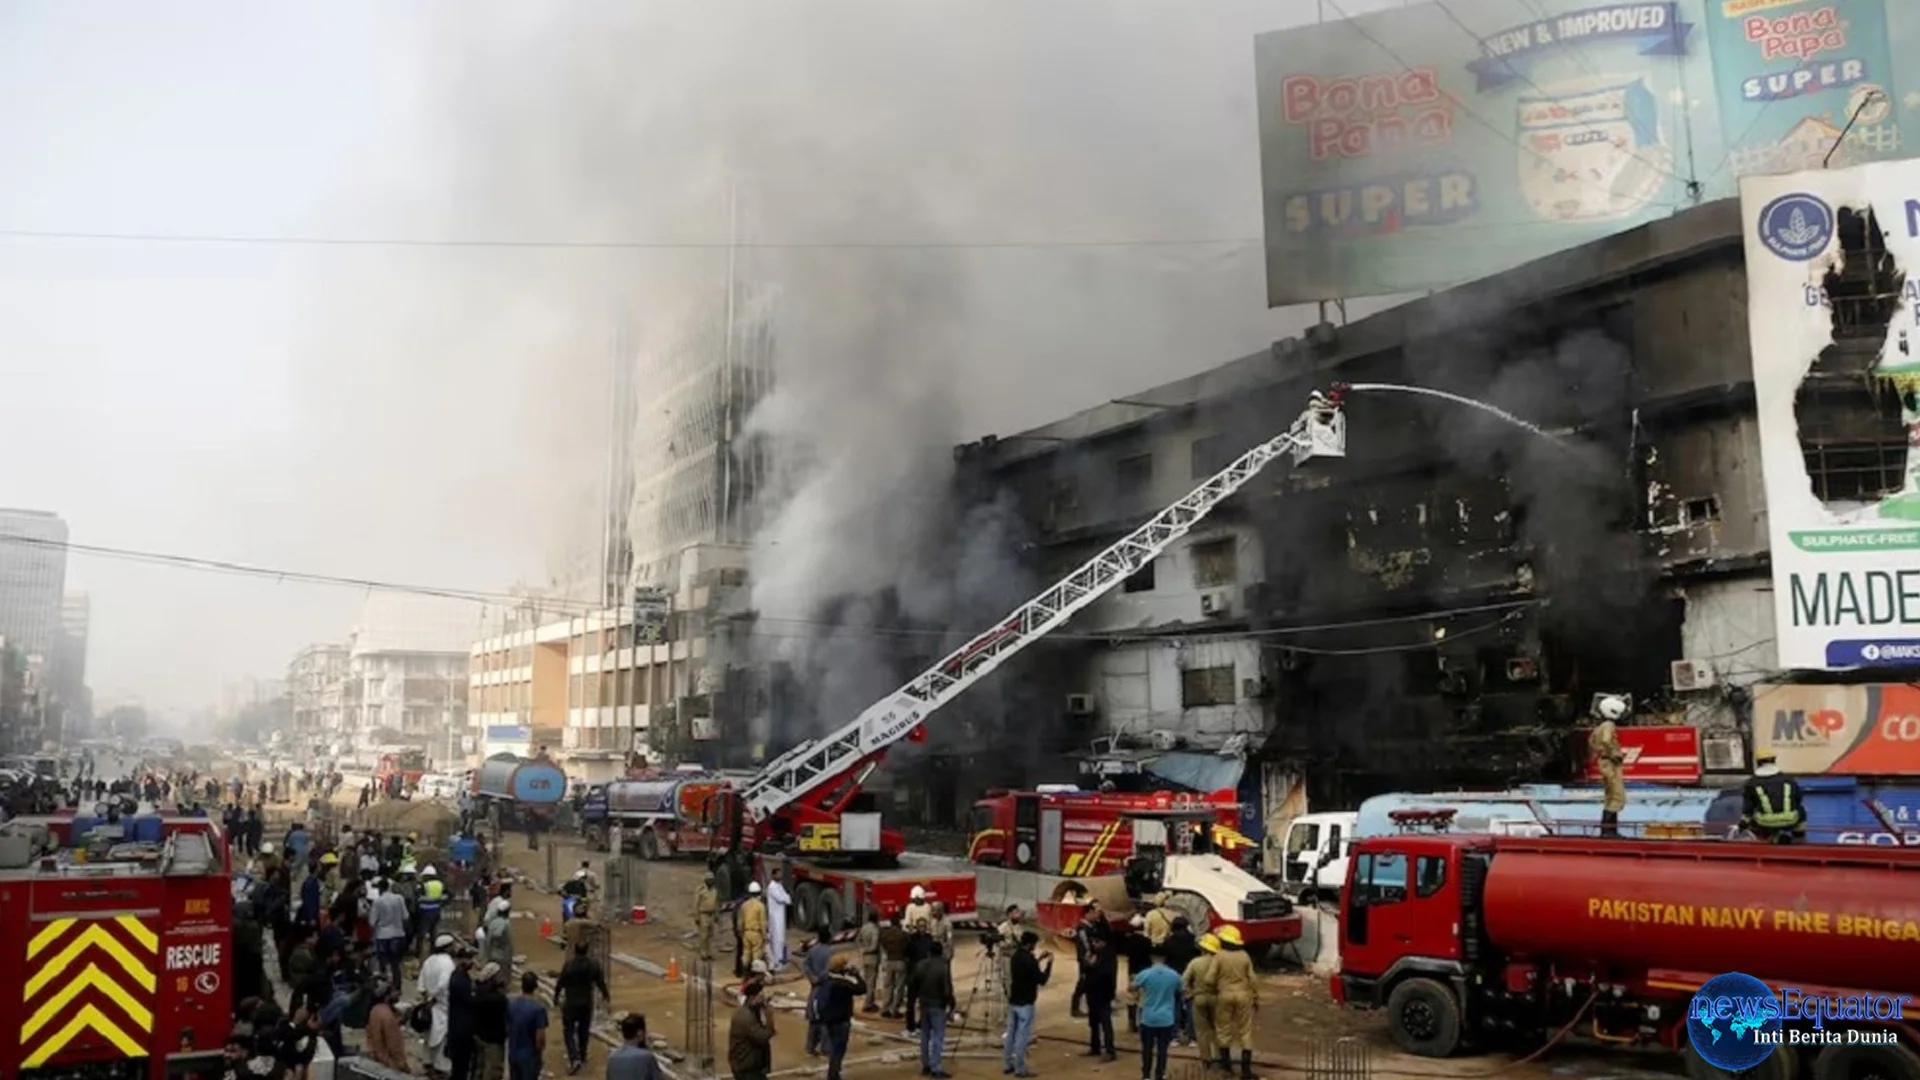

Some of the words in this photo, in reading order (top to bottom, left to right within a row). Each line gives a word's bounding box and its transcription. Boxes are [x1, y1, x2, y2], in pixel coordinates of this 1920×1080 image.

[1484, 27, 1531, 58] NEW
[1535, 24, 1552, 44] &
[1557, 5, 1665, 38] IMPROVED
[1744, 8, 1835, 40] Bona
[1763, 30, 1844, 60] Papa
[1283, 68, 1439, 124] Bona
[1743, 59, 1863, 98] SUPER
[1285, 174, 1474, 232] SUPER
[1790, 570, 1920, 627] MADE
[870, 710, 920, 745] MAGIRUS
[1772, 708, 1844, 742] M&P
[1588, 897, 1695, 926] PAKISTAN
[1701, 905, 1764, 930] NAVY
[1773, 909, 1830, 934] FIRE
[1836, 912, 1920, 942] BRIGA
[166, 943, 221, 970] RESCUE
